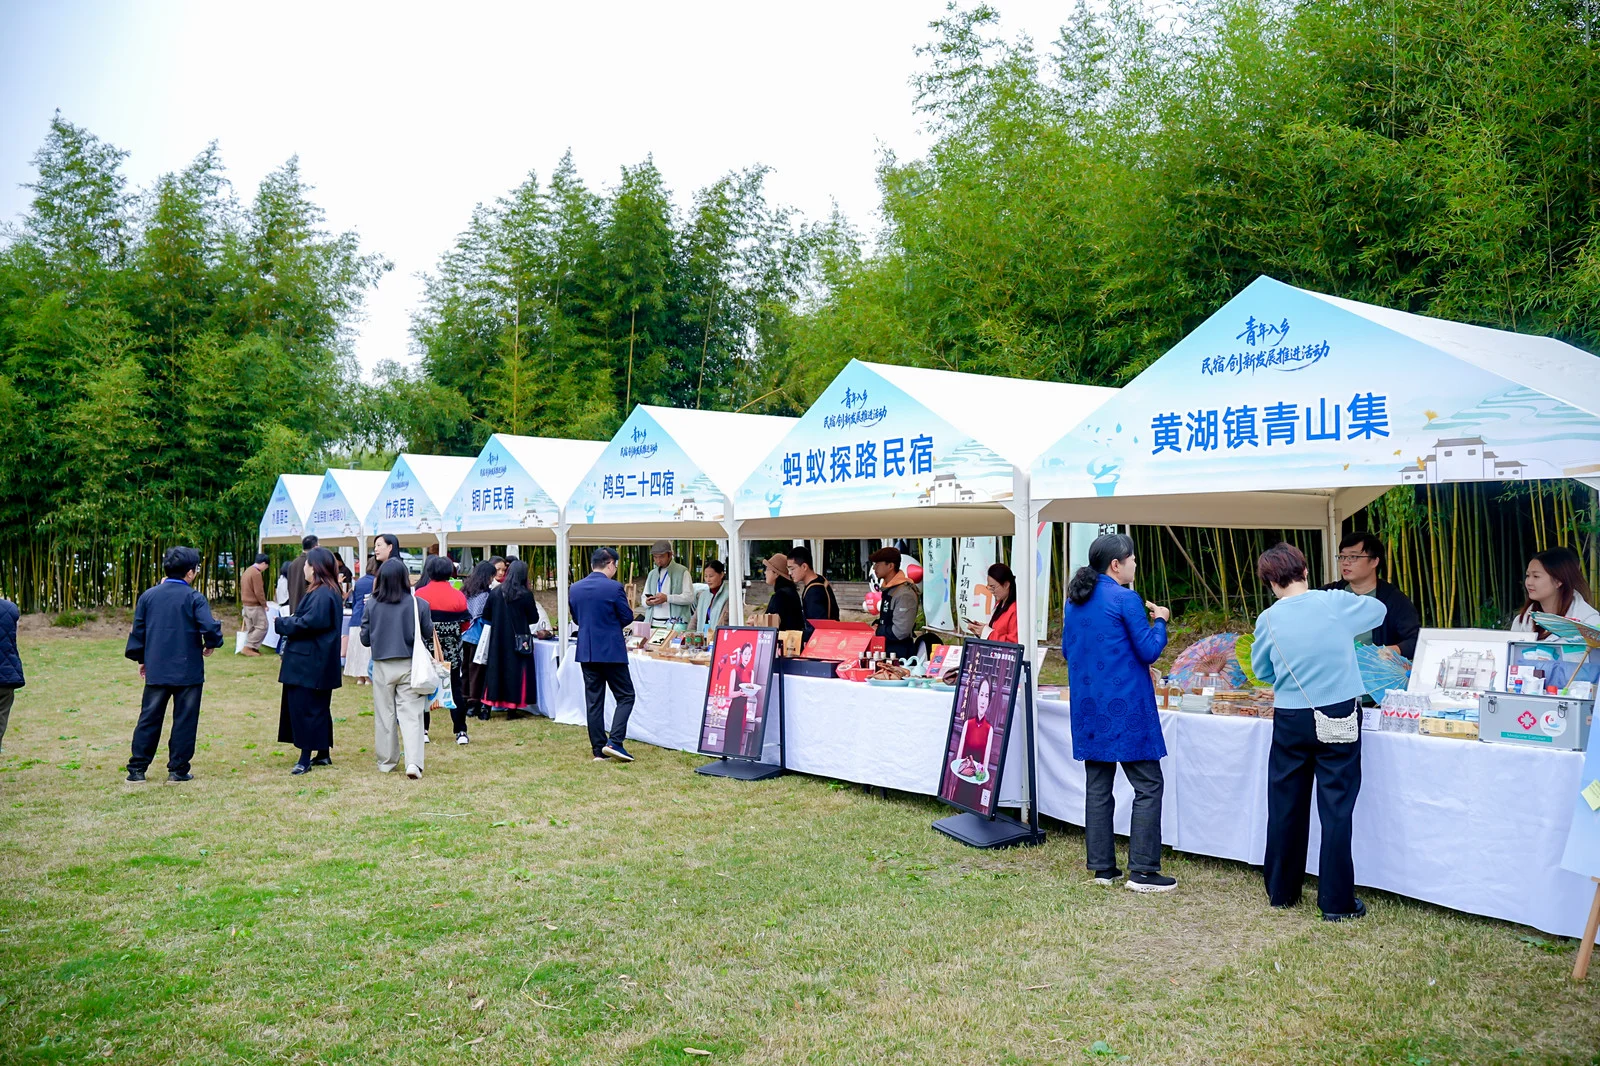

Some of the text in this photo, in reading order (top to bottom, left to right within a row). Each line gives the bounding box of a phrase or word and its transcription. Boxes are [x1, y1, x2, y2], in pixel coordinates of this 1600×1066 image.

[1235, 315, 1291, 347] 青年入乡
[1201, 339, 1331, 376] 民宿创新发展推进活动
[1149, 391, 1391, 456] 黄湖镇青山集
[782, 433, 934, 487] 蚂蚁探路民宿
[602, 469, 675, 500] 鸬鸟二十四宿
[385, 497, 415, 520] 竹家民宿
